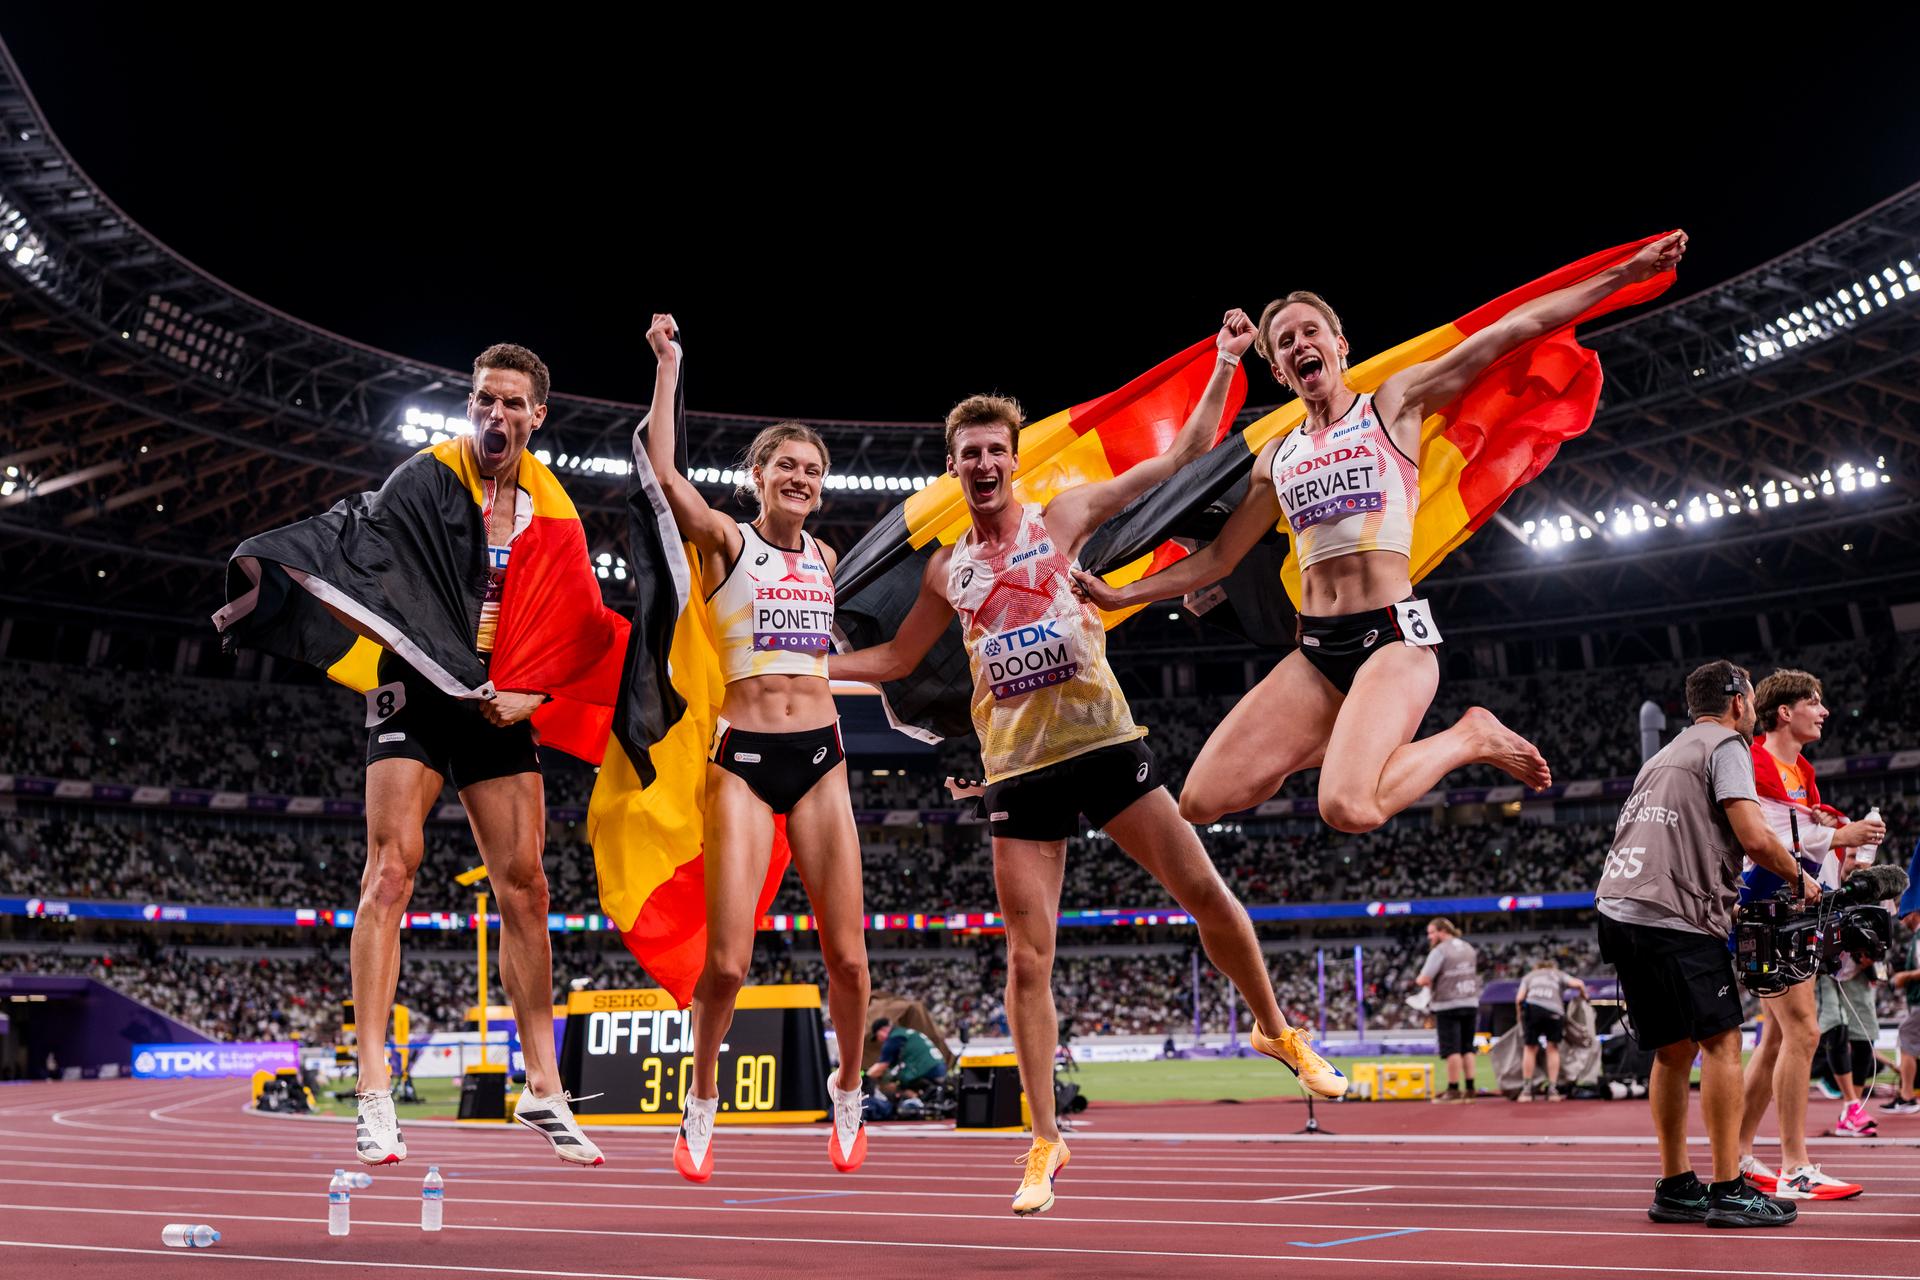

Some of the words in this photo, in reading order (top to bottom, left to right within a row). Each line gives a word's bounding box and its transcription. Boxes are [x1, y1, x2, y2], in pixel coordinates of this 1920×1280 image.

[1333, 424, 1360, 439] Allianz
[1280, 445, 1375, 485] HONDA
[1282, 466, 1373, 511] VERVAET
[1012, 549, 1038, 565] Allianz
[755, 588, 834, 605] HONDA
[999, 620, 1062, 651] TDK
[989, 643, 1068, 682] DOOM
[376, 690, 395, 719] 8
[593, 993, 658, 1010] SEIKO
[155, 1051, 215, 1072] TDK
